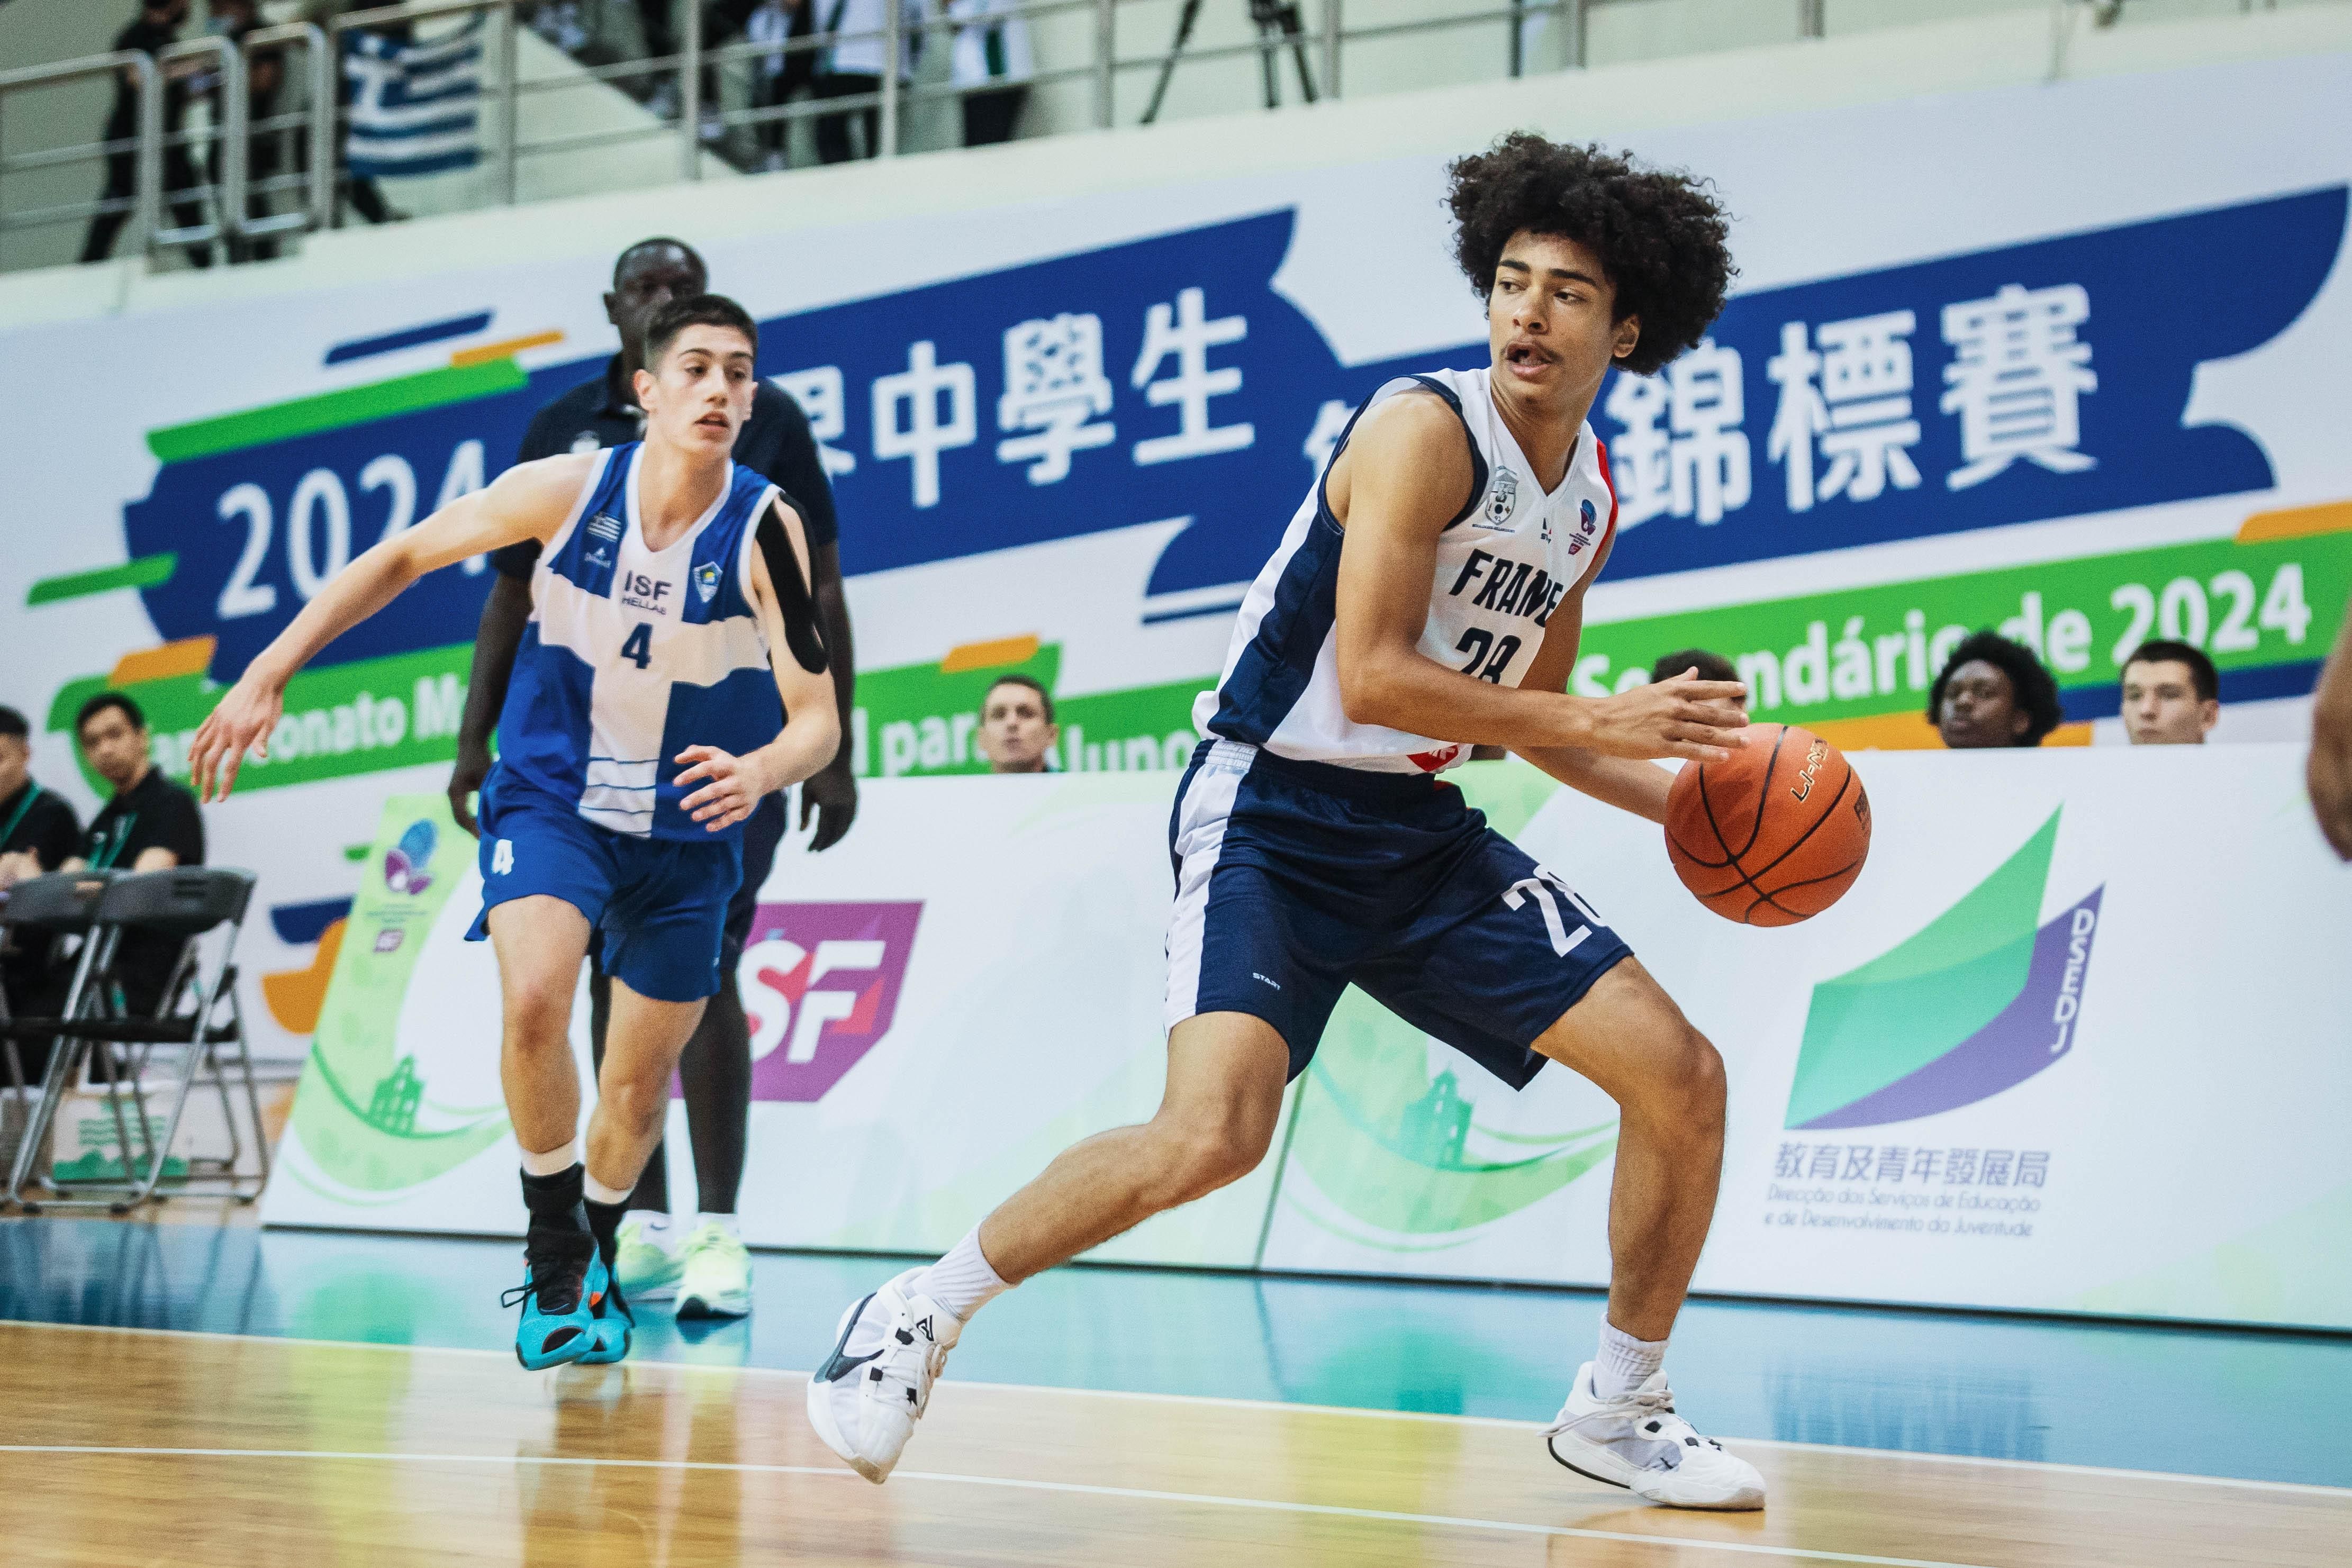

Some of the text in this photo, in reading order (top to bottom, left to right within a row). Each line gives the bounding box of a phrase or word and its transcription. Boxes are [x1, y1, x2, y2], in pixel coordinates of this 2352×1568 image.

[624, 570, 672, 601] ISF
[2111, 563, 2312, 667] 2024
[620, 622, 653, 669] 4
[491, 838, 515, 876] 4
[736, 939, 886, 1063] SF
[2050, 908, 2095, 1054] DSEDJ
[1774, 1141, 2050, 1188] 教育及青年發展局
